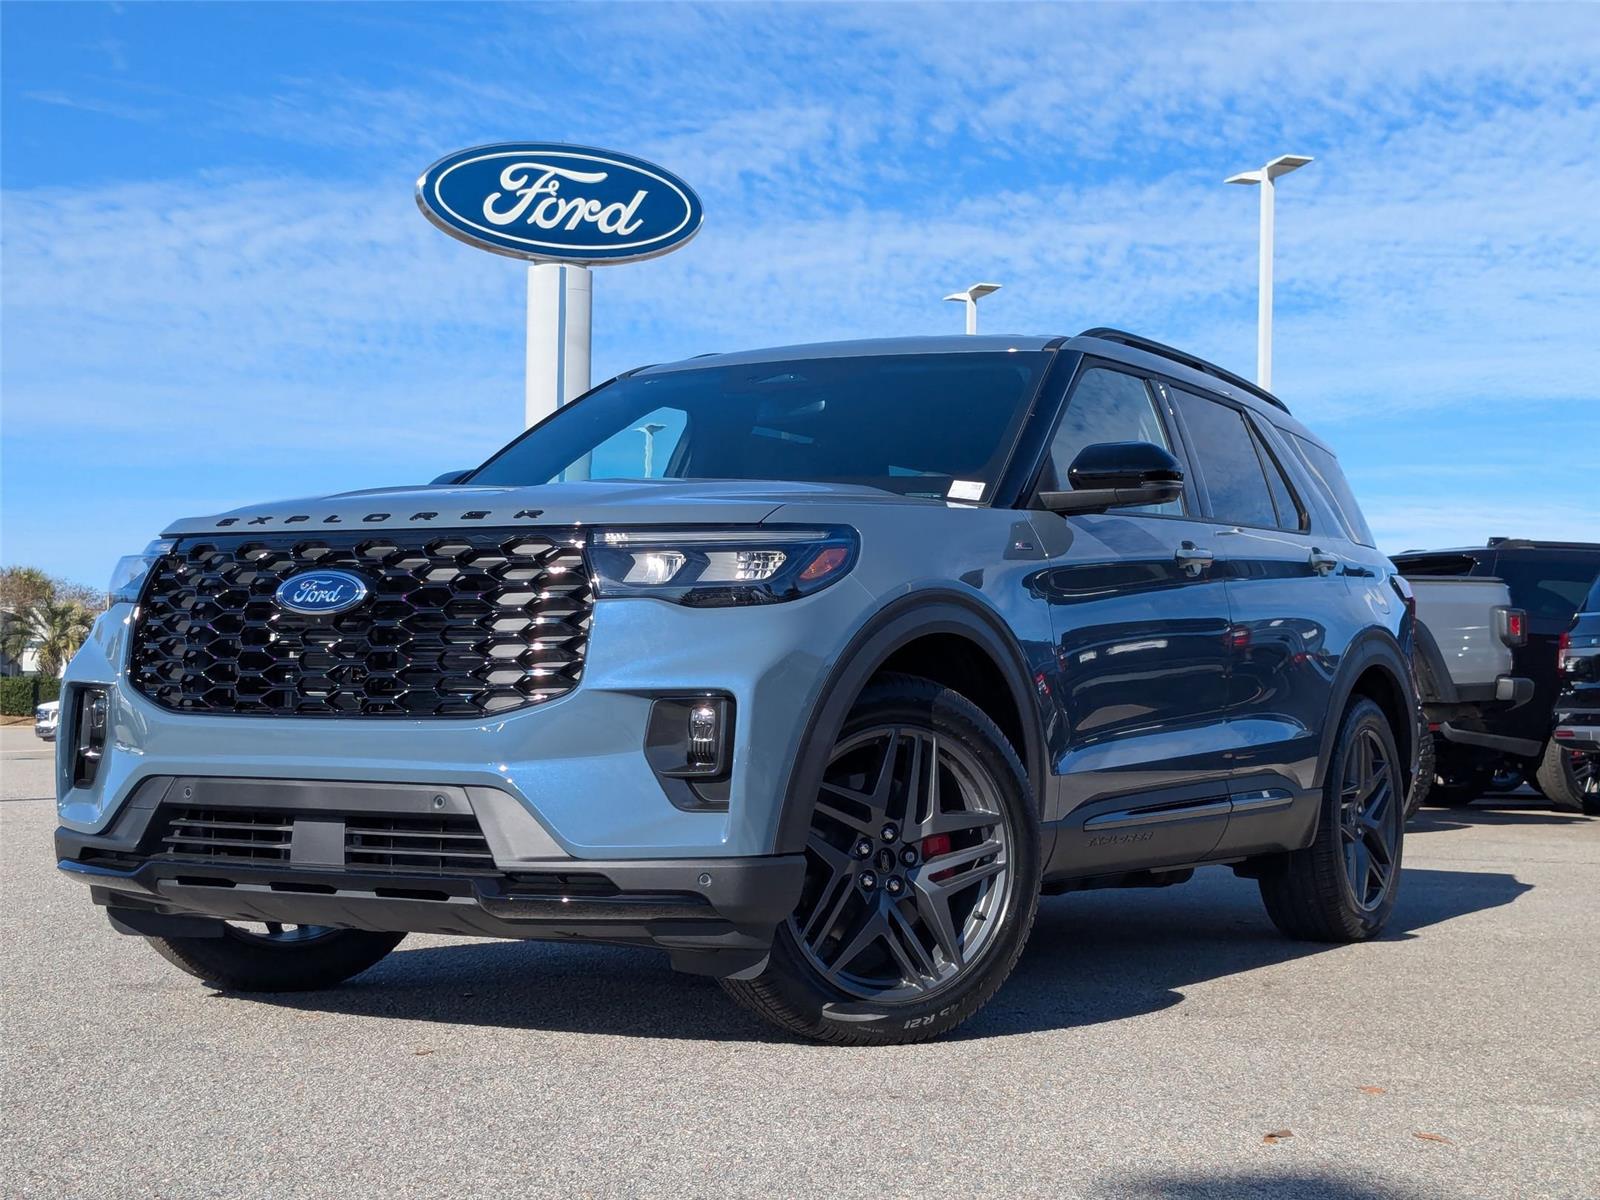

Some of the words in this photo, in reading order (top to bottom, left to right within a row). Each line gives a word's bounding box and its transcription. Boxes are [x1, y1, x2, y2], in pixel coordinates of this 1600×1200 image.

[483, 162, 648, 236] Ford
[215, 509, 545, 527] EXPLORER
[293, 579, 341, 603] Ford
